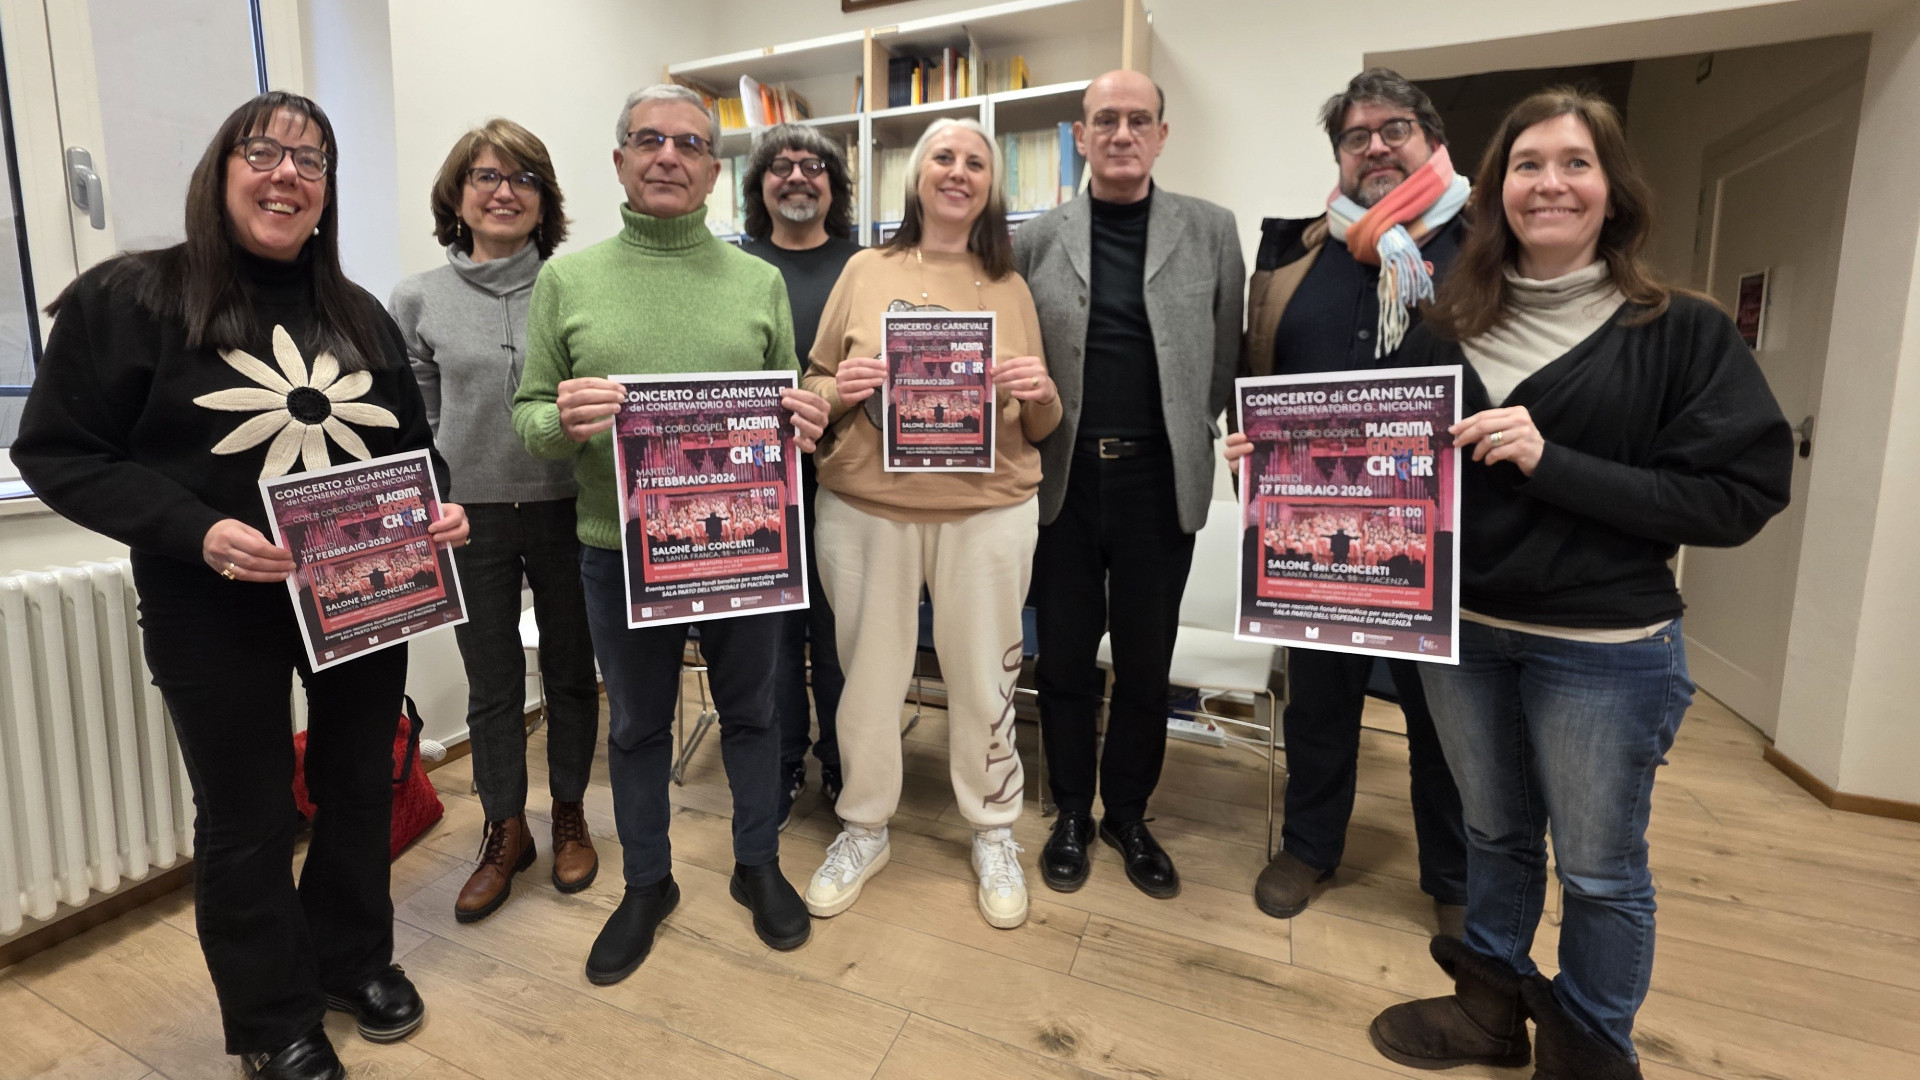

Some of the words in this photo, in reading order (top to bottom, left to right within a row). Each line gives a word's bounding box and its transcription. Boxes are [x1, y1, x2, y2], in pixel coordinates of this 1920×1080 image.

[695, 388, 707, 399] di
[1245, 391, 1326, 406] CONCERTO
[1329, 390, 1343, 402] di
[1346, 384, 1444, 401] CARNEVALE
[630, 403, 643, 411] del
[646, 400, 723, 411] CONSERVATORIO
[725, 400, 735, 408] G.
[737, 398, 777, 407] NICOLINI
[1273, 403, 1361, 415] CONSERVATORIO
[1379, 400, 1431, 411] NICOLINI
[633, 425, 654, 434] CON
[664, 423, 690, 433] CORO
[691, 422, 724, 432] GOSPEL
[727, 415, 779, 430] PLACENTIA
[1365, 421, 1433, 437] PLACENTIA
[727, 428, 780, 447] GOSPEL
[1365, 436, 1433, 456] GOSPEL
[274, 479, 342, 500] CONCERTO
[343, 476, 355, 486] di
[356, 463, 422, 483] CARNEVALE
[636, 478, 649, 488] 17
[651, 475, 707, 487] FEBBRAIO
[710, 473, 736, 483] 2026
[285, 497, 299, 506] del
[300, 483, 370, 503] CONSERVATORIO
[381, 473, 416, 486] NICOLINI
[375, 486, 421, 504] PLACENTIA
[750, 488, 775, 497] 21:00
[1258, 484, 1272, 494] 17
[1274, 484, 1336, 495] FEBBRAIO
[1341, 485, 1372, 496] 2026
[377, 495, 424, 517] GOSPEL
[1389, 506, 1421, 517] 21:00
[302, 554, 315, 564] 17
[316, 541, 366, 560] FEBBRAIO
[368, 535, 391, 547] 2026
[404, 540, 426, 551] 21:00
[651, 544, 689, 555] SALONE
[708, 539, 754, 550] CONCERTI
[1267, 559, 1309, 570] SALONE
[1331, 563, 1389, 576] CONCERTI
[325, 597, 358, 612] SALONE
[374, 581, 415, 597] CONCERTI
